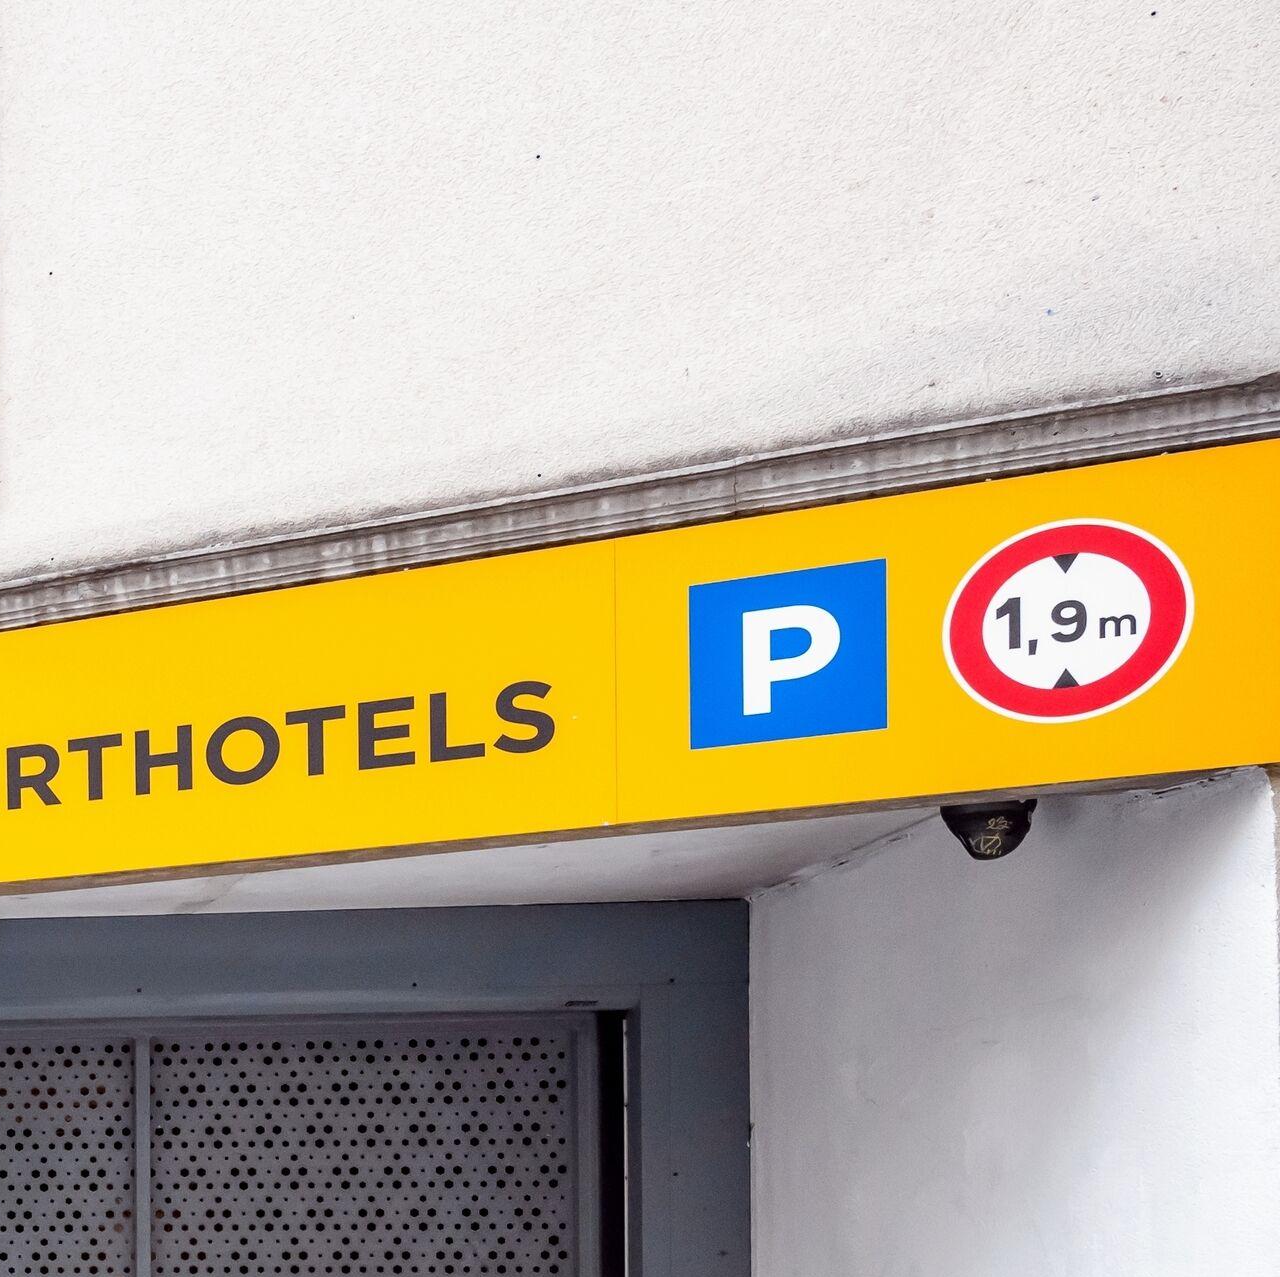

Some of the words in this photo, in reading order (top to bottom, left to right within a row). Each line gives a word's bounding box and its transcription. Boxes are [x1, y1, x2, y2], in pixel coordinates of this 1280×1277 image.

[742, 604, 841, 716] P
[995, 596, 1088, 656] 1,9
[1099, 613, 1137, 639] m
